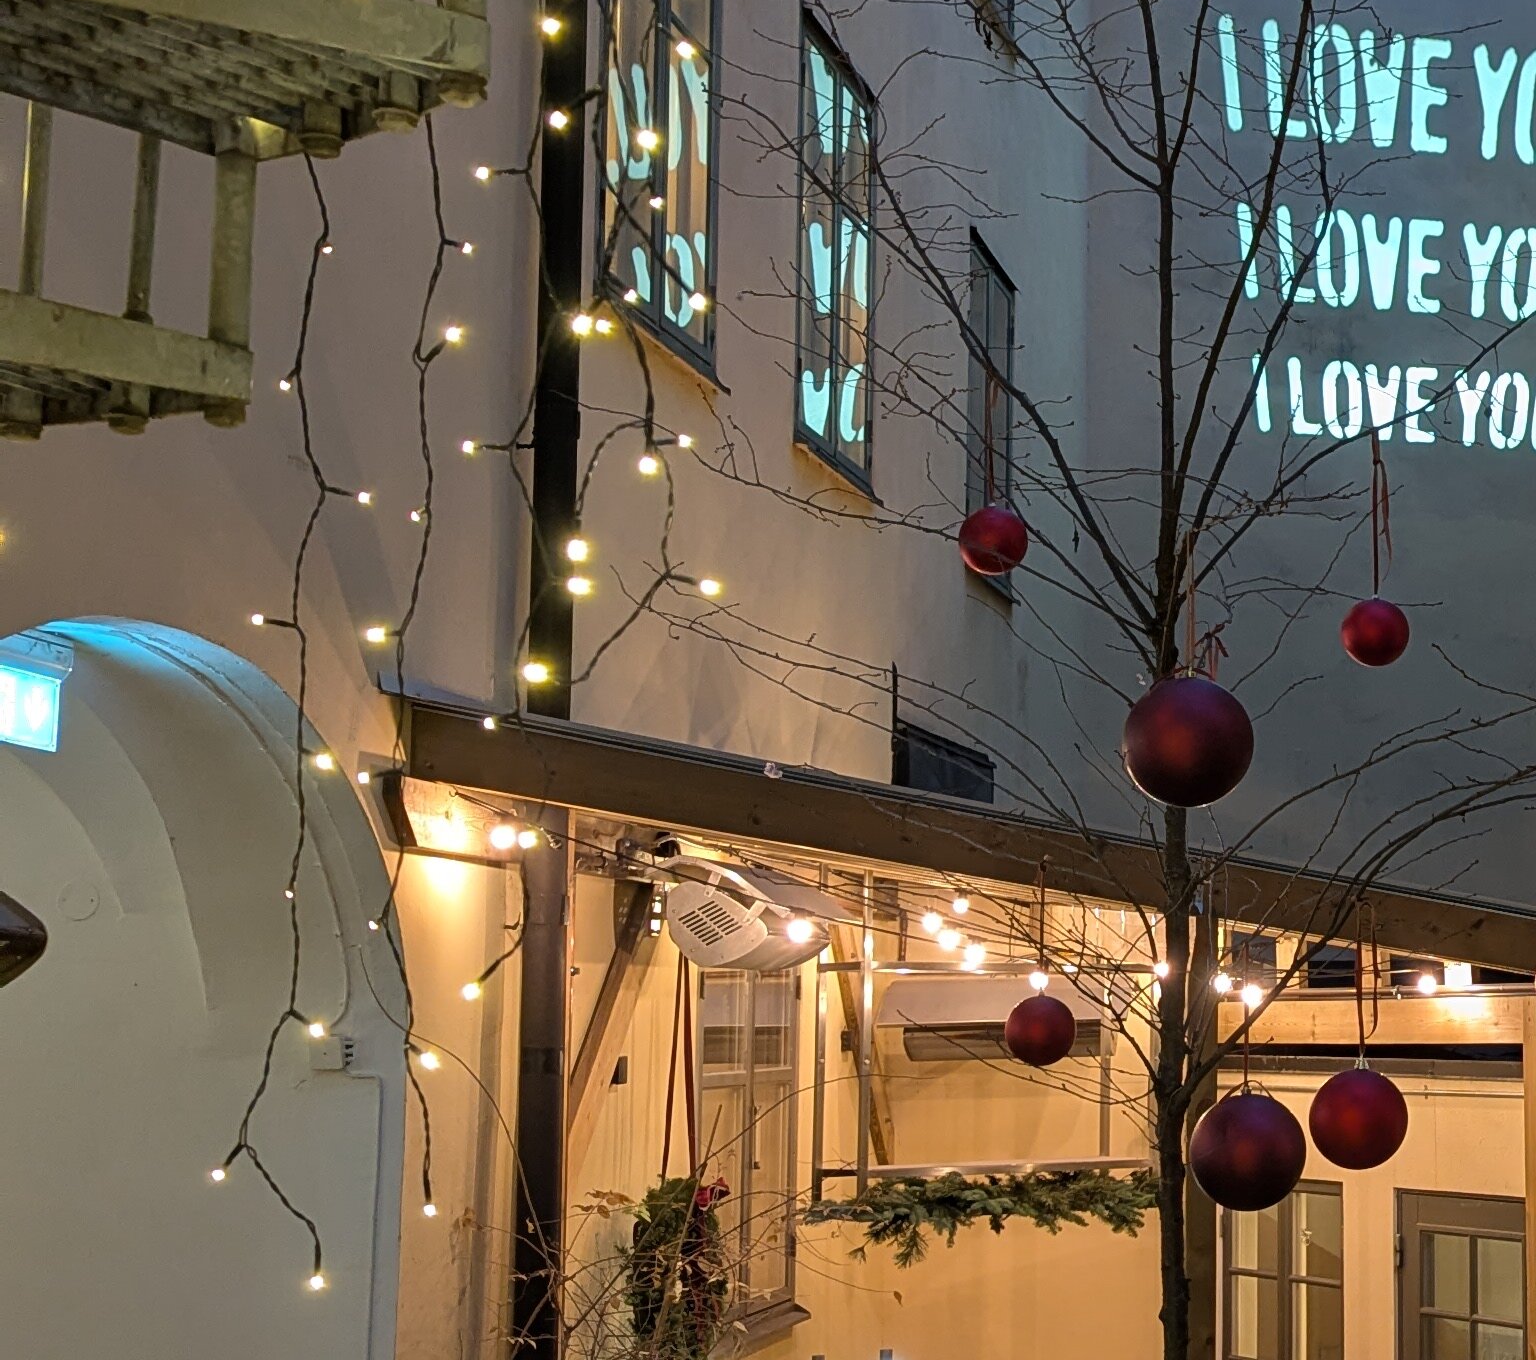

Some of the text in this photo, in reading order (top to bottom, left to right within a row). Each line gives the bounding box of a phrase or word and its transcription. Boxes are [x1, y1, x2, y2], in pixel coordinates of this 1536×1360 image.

[1217, 13, 1243, 132] I
[1262, 18, 1452, 154] LOVE
[1236, 202, 1259, 299] I
[1276, 205, 1445, 314] LOVE
[1251, 353, 1272, 433] I
[1287, 356, 1439, 444] LOVE
